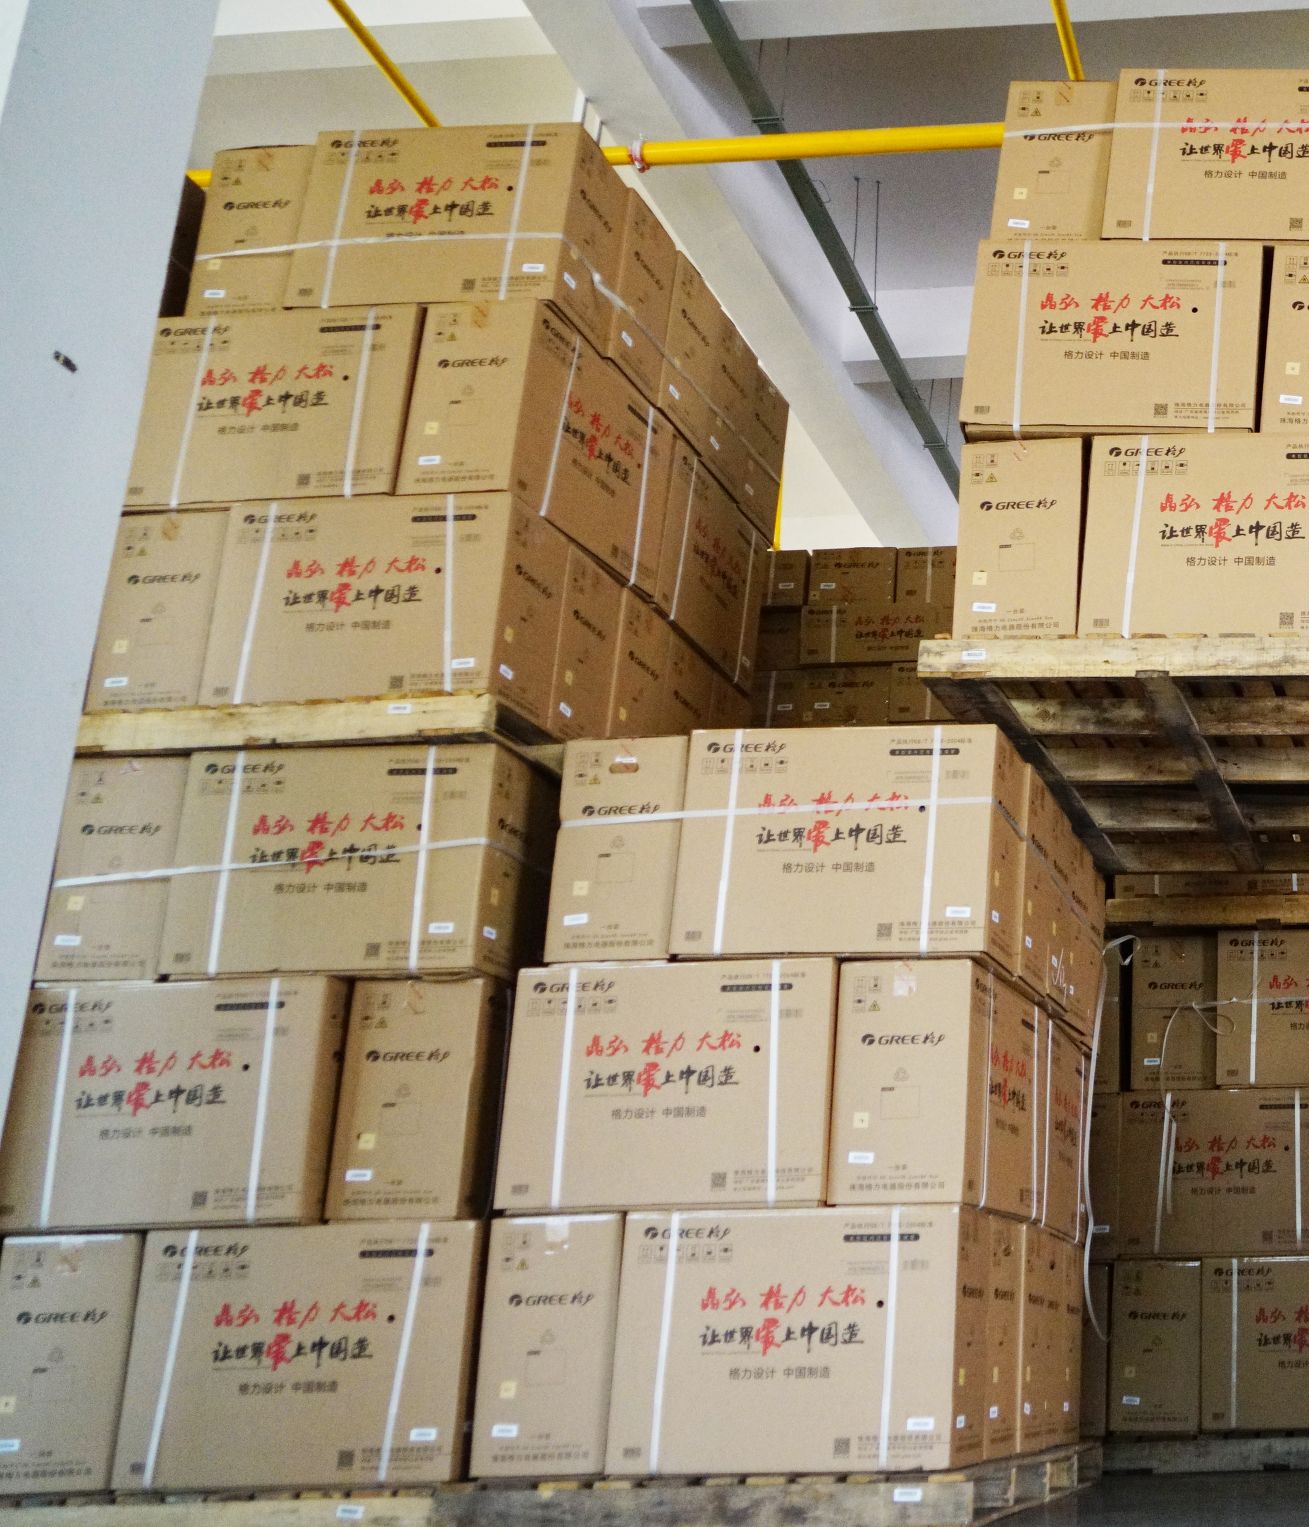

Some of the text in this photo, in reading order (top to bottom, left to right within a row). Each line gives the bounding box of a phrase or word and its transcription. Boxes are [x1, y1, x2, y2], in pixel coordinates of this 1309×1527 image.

[1204, 170, 1242, 178] 格力设计
[415, 175, 452, 195] 格力
[1090, 292, 1129, 313] 格力
[1140, 294, 1180, 310] 大松
[1064, 351, 1150, 359] 格力设计 中国制造
[247, 363, 285, 385] 格力
[1212, 490, 1253, 514] 格力
[1264, 492, 1305, 510] 大松
[336, 555, 375, 578] 格力
[1186, 556, 1275, 565] 格力设计 中国制造
[307, 810, 349, 836] 格力
[783, 862, 874, 872] 格力设计 中国制造
[641, 1030, 684, 1057] 格力
[696, 1030, 740, 1051] 大松
[133, 1049, 176, 1076] 格力
[611, 1106, 706, 1119] 格力设计 中国制造
[759, 1282, 805, 1312] 格力
[818, 1284, 865, 1307] 大松
[273, 1298, 319, 1328] 格力
[729, 1366, 829, 1379] 格力设计 中国制造
